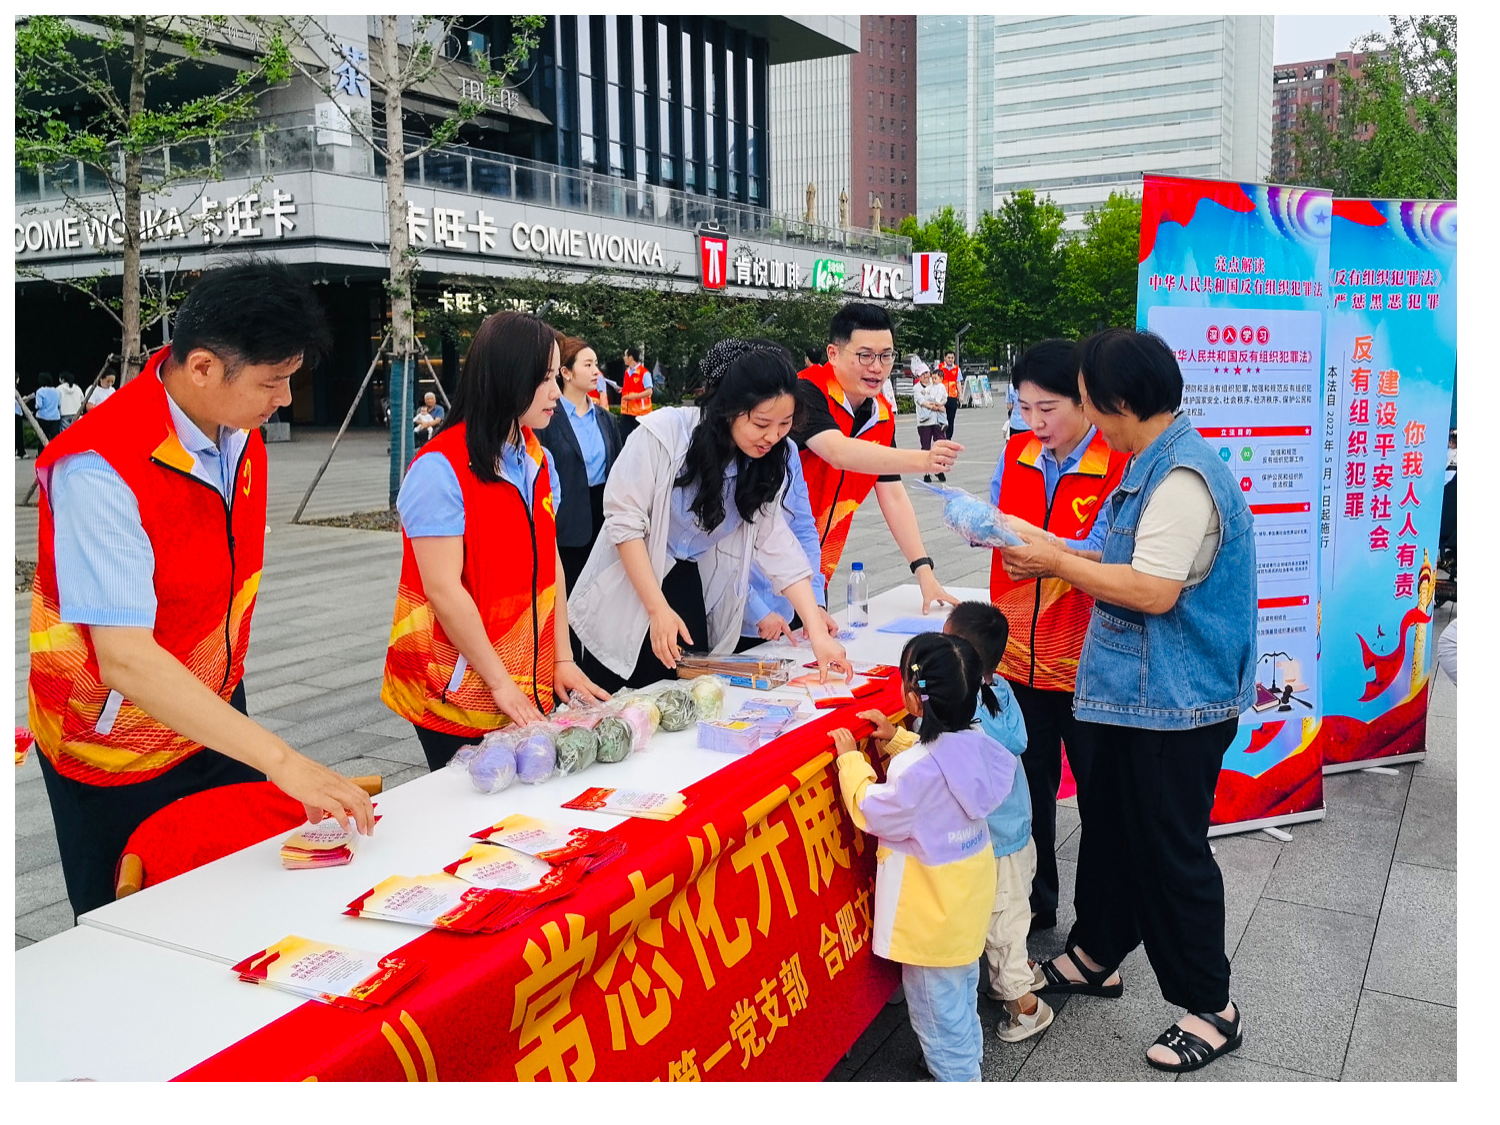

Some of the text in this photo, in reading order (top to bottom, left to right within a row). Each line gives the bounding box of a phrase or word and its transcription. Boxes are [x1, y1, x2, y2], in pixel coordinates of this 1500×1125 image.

[15, 217, 81, 253] COME
[192, 189, 297, 242] 卡旺卡
[406, 201, 664, 266] 卡旺卡 COME WONKA
[734, 257, 800, 290] 肯悦咖啡
[862, 263, 904, 300] KFC
[1149, 274, 1323, 298] 中华人民共和国反有组织犯罪法
[1215, 255, 1265, 275] 亮点解读
[1208, 327, 1269, 343] 深入学习
[1344, 335, 1373, 519] 反有组织犯罪
[1370, 369, 1400, 550] 建设平安社会
[1394, 420, 1426, 598] 你我人人有责
[510, 750, 864, 1081] 常态化开展
[652, 877, 875, 1081] 第一党支部 合肥文
